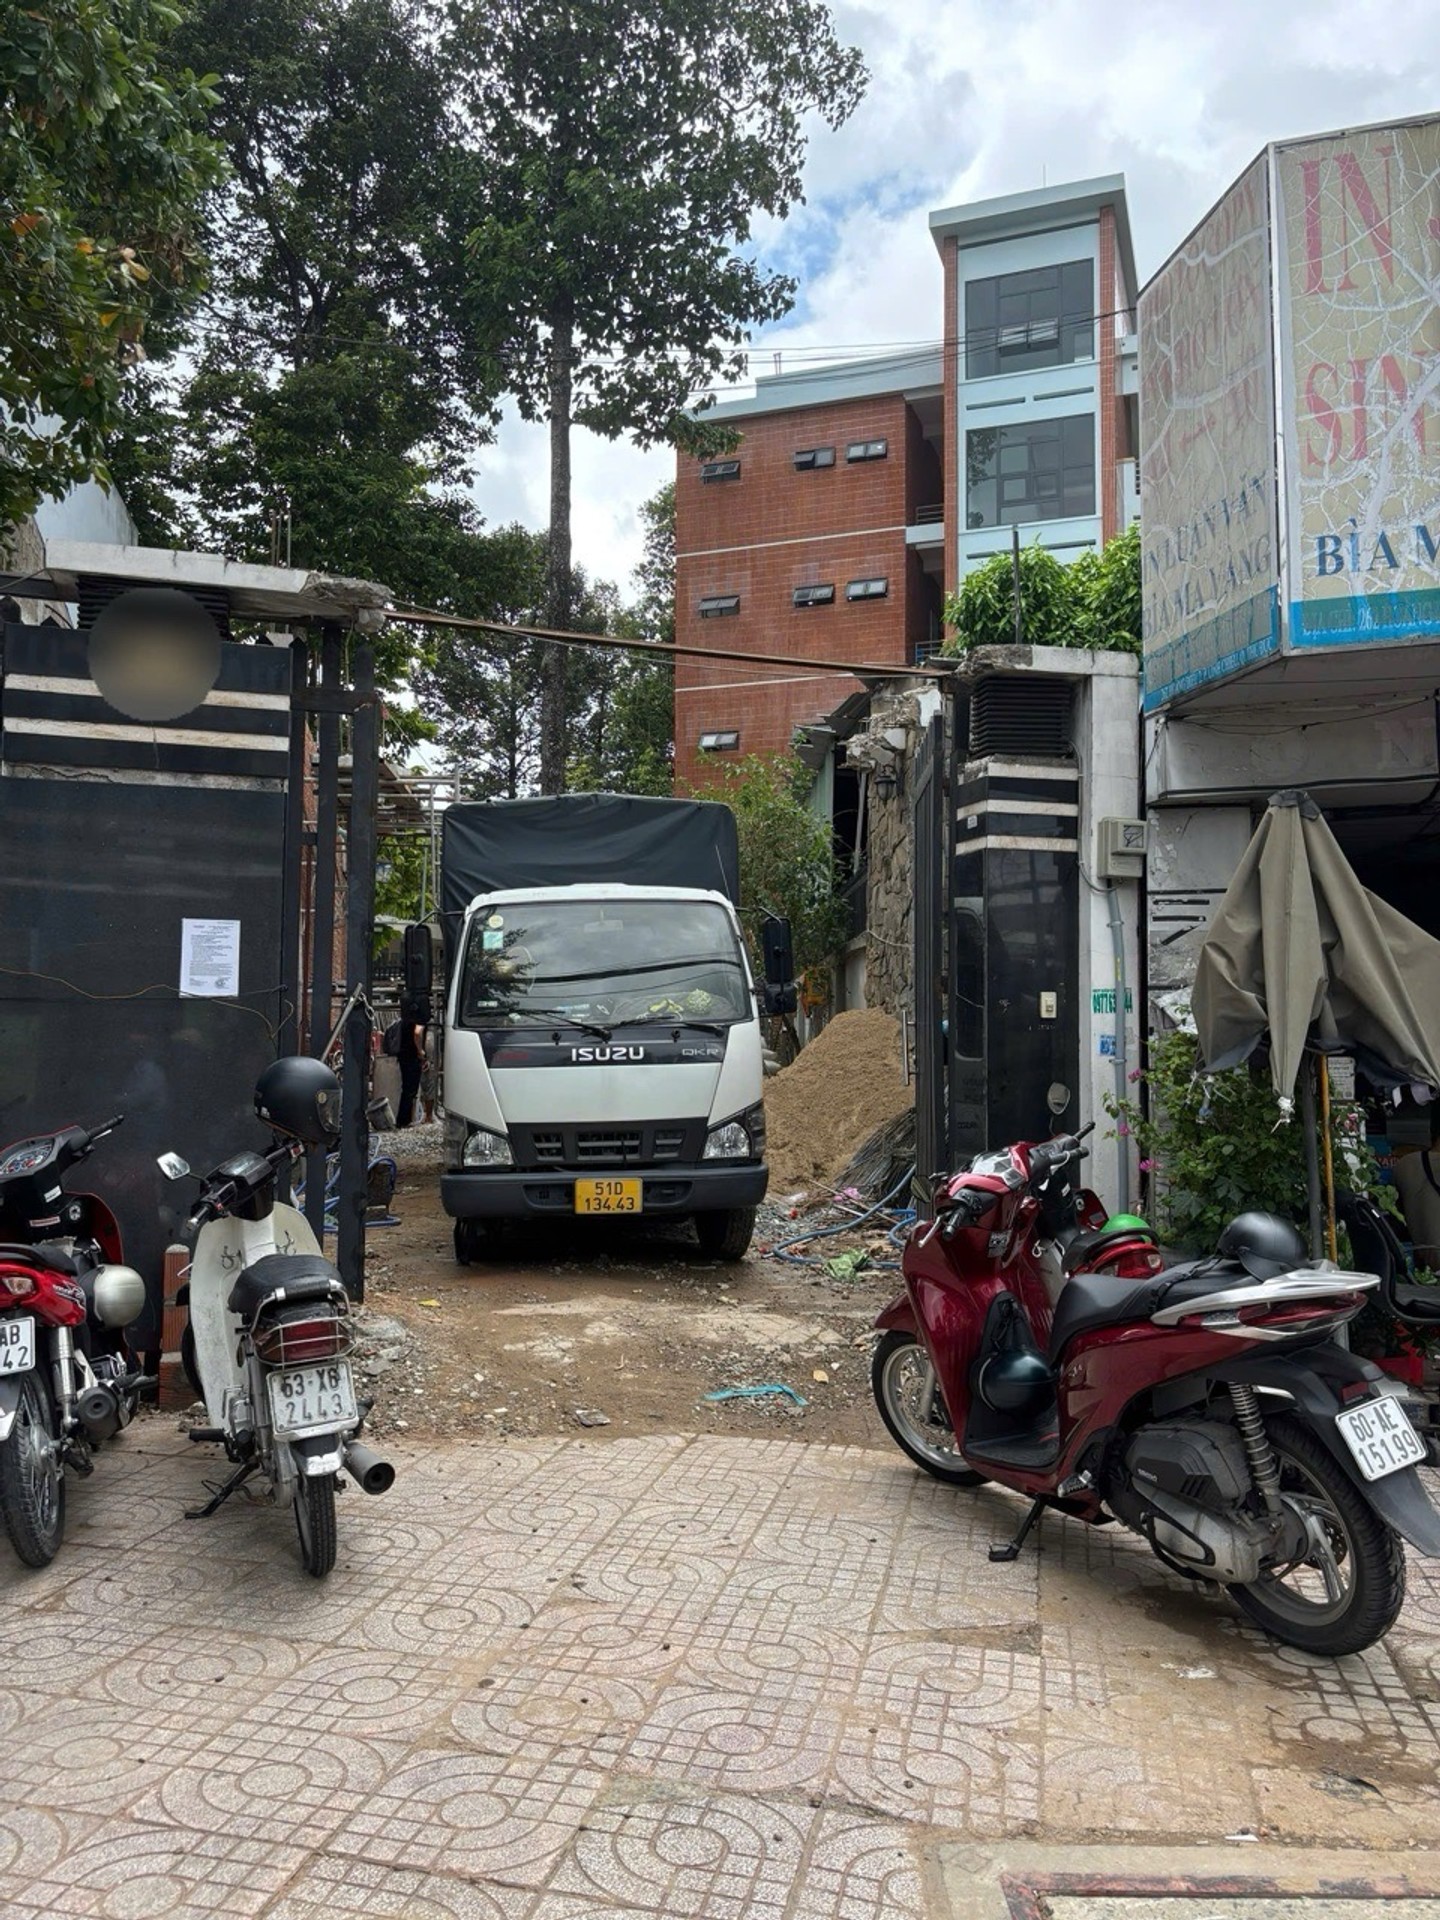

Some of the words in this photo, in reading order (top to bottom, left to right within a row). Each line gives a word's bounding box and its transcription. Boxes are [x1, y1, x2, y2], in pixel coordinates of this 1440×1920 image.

[1315, 517, 1400, 576] BÌA
[571, 1046, 645, 1061] ISUZU
[682, 1048, 720, 1056] QKR
[595, 1181, 624, 1196] 51D
[585, 1197, 635, 1211] 134.43
[3, 1345, 28, 1369] 42
[286, 1393, 343, 1424] 2443
[1358, 1429, 1419, 1474] 151.99
